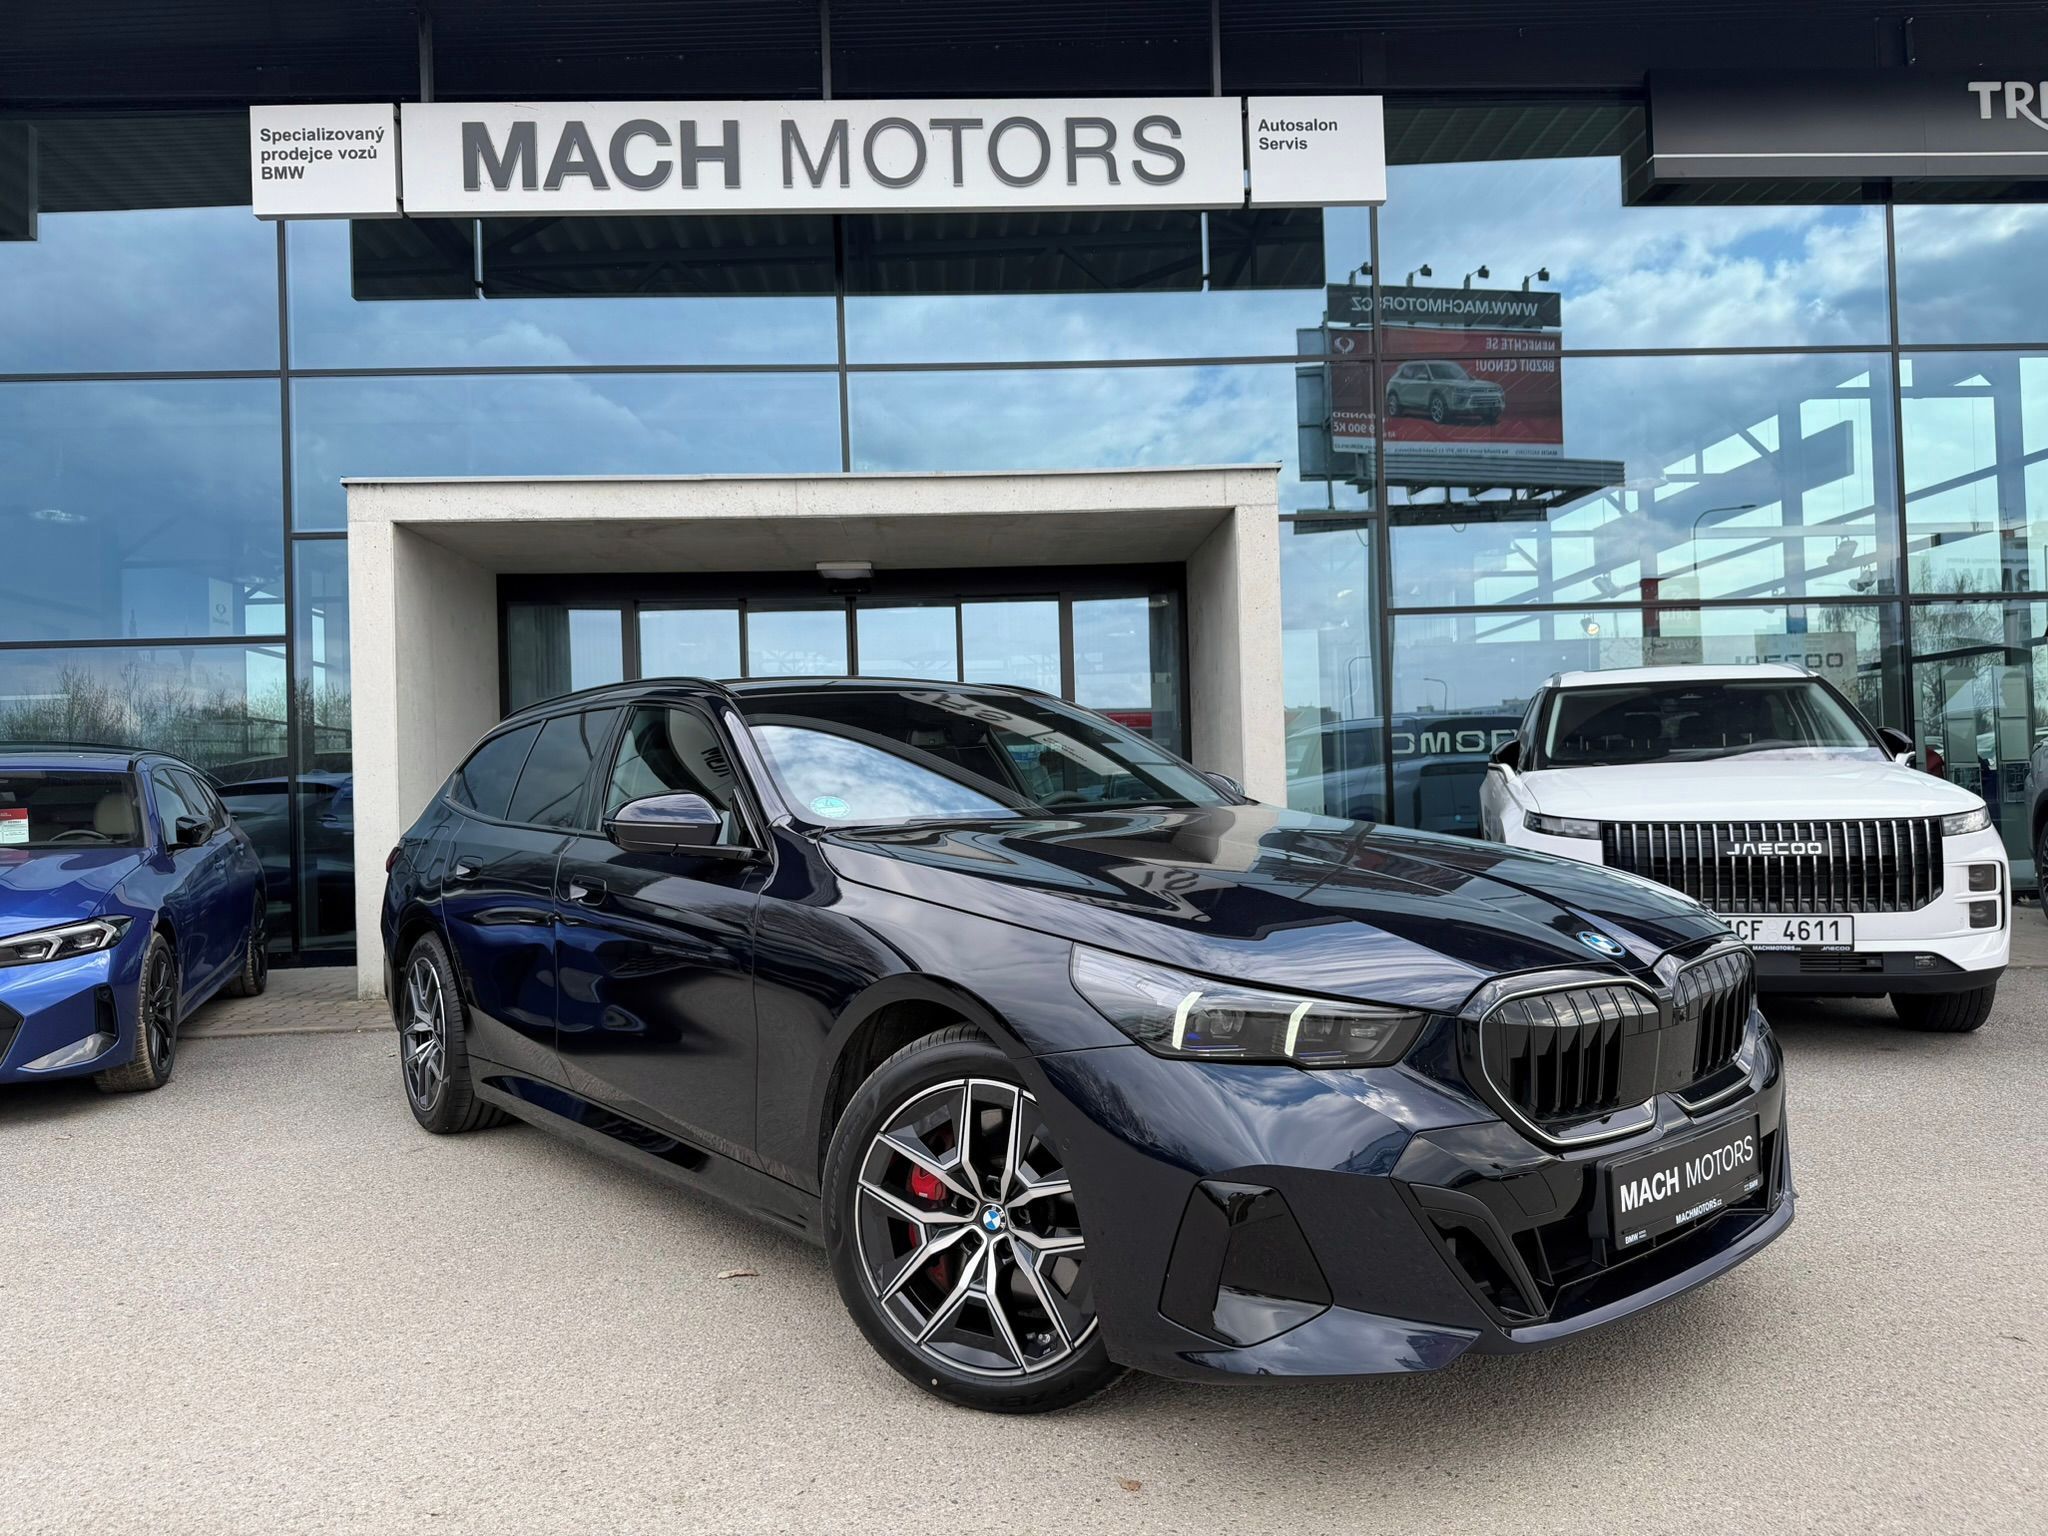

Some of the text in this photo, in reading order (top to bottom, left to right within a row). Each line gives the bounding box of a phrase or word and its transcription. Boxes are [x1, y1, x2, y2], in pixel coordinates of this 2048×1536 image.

[1258, 118, 1338, 132] Autosalon
[259, 126, 385, 145] Specializovaný
[1259, 137, 1308, 150] Servis
[261, 145, 377, 164] prodejce vozů
[462, 114, 1186, 192] MACH MOTORS
[261, 165, 305, 180] BMW
[1726, 842, 1823, 856] JAECOO
[1783, 920, 1839, 941] 4611
[1620, 1135, 1754, 1213] MACH MOTORS
